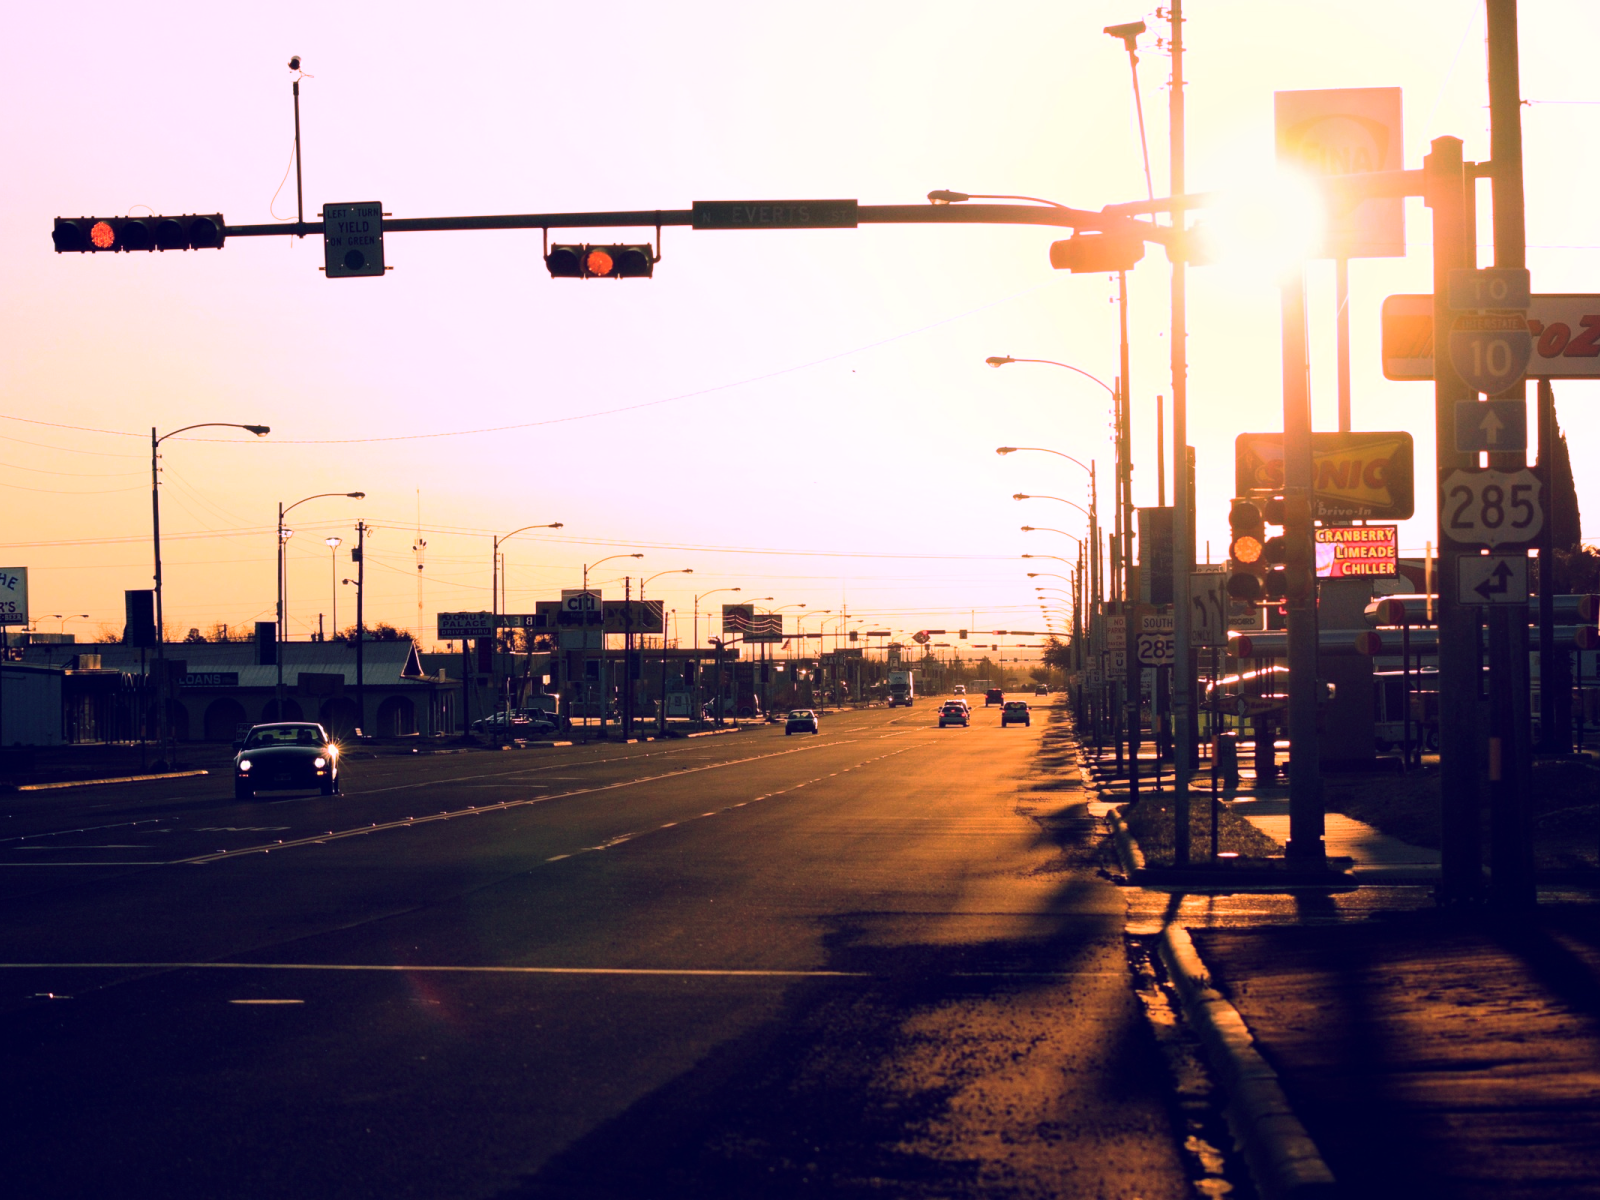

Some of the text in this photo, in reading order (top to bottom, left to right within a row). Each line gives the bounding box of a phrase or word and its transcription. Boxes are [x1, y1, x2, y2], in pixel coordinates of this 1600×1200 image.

[327, 207, 379, 218] LEFT TURN
[702, 205, 847, 223] N EVERTS ST
[338, 221, 369, 233] YIELD
[330, 236, 375, 246] ON GREEN
[1469, 278, 1508, 300] TO
[1461, 317, 1519, 330] INTERSTATE
[1471, 339, 1512, 378] 10
[1265, 458, 1391, 490] SNIC
[1317, 506, 1372, 516] Drive-In
[1450, 484, 1535, 530] 285
[1315, 529, 1394, 542] CRANBERRY
[1335, 545, 1395, 559] LIMEADE
[1341, 562, 1395, 575] CHILLER
[443, 620, 487, 628] PALACE
[1113, 618, 1124, 626] NO
[1143, 617, 1173, 628] SOUTH
[1227, 617, 1256, 626] ASCARD
[1192, 630, 1211, 641] ONLY
[1140, 639, 1175, 659] 285
[1116, 659, 1124, 667] U
[178, 673, 221, 685] LOANS
[238, 723, 252, 731] FRE
